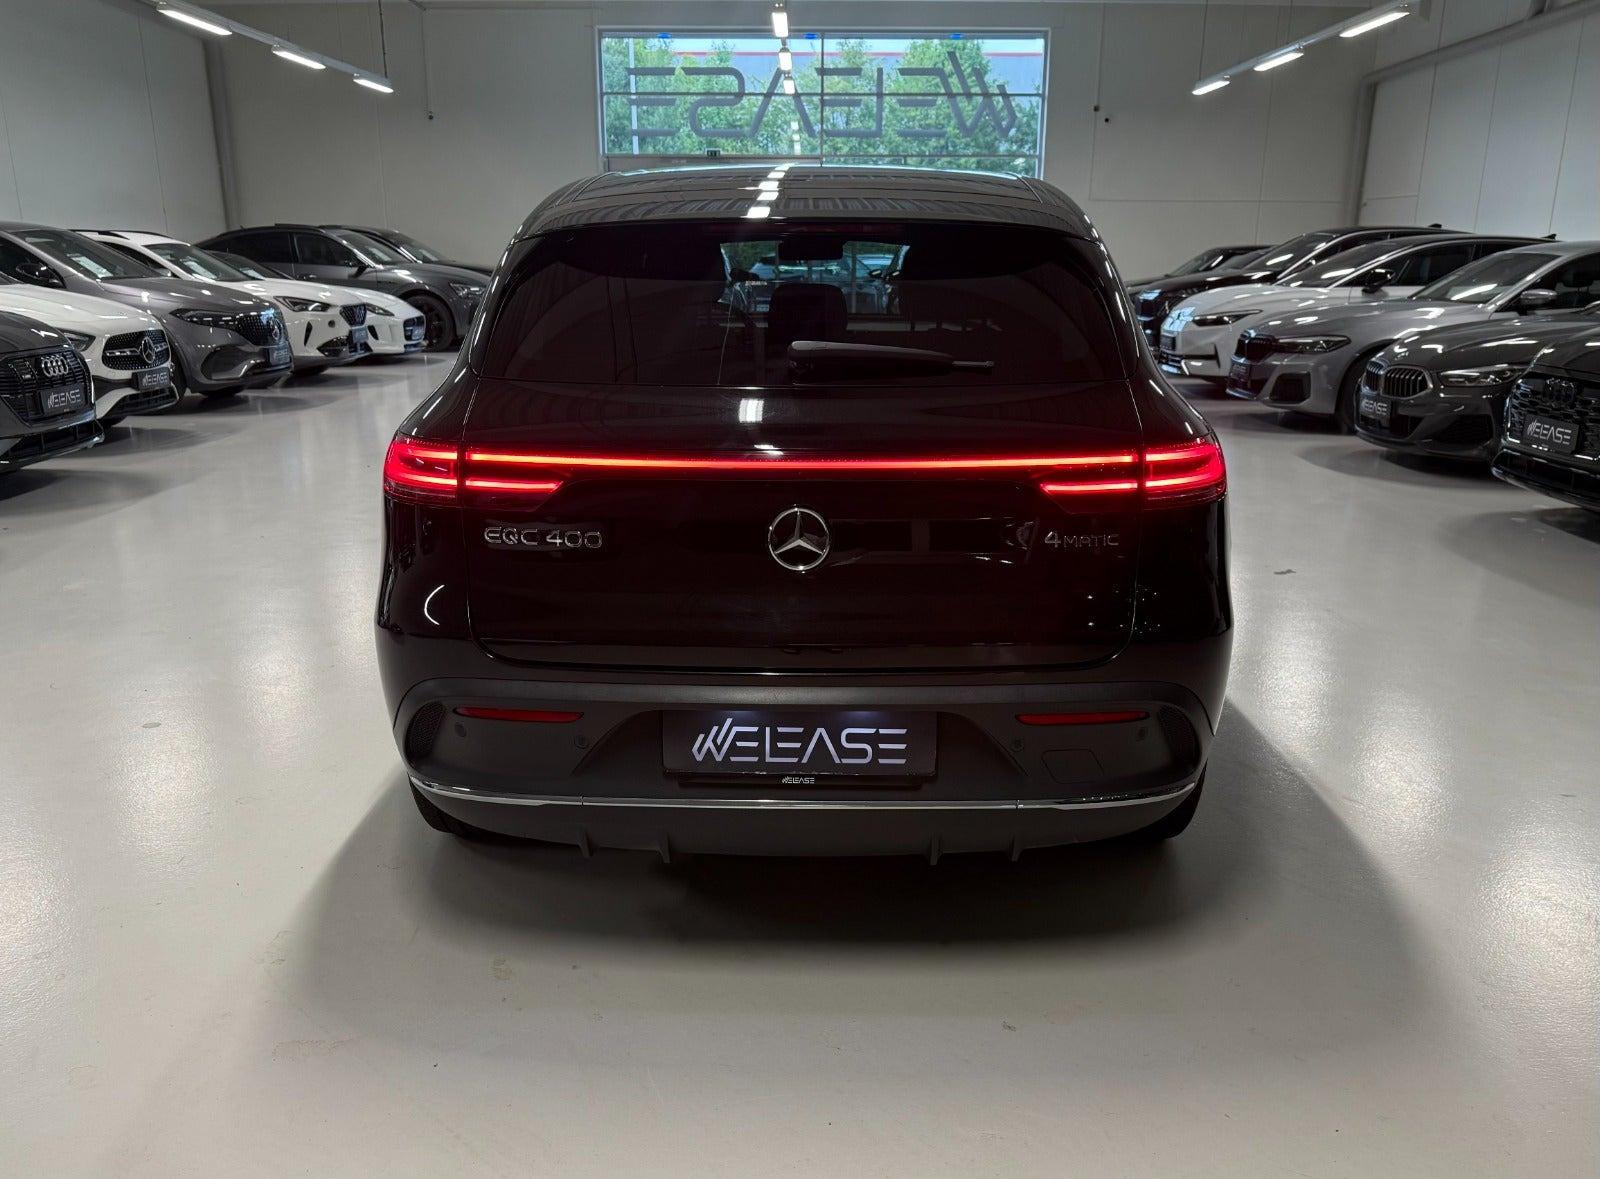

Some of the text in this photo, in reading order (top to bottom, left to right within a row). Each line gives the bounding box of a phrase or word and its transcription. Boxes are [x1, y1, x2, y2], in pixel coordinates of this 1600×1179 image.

[1527, 419, 1572, 445] WELEASE
[484, 526, 603, 548] EQC 400
[691, 717, 908, 764] WELEASE
